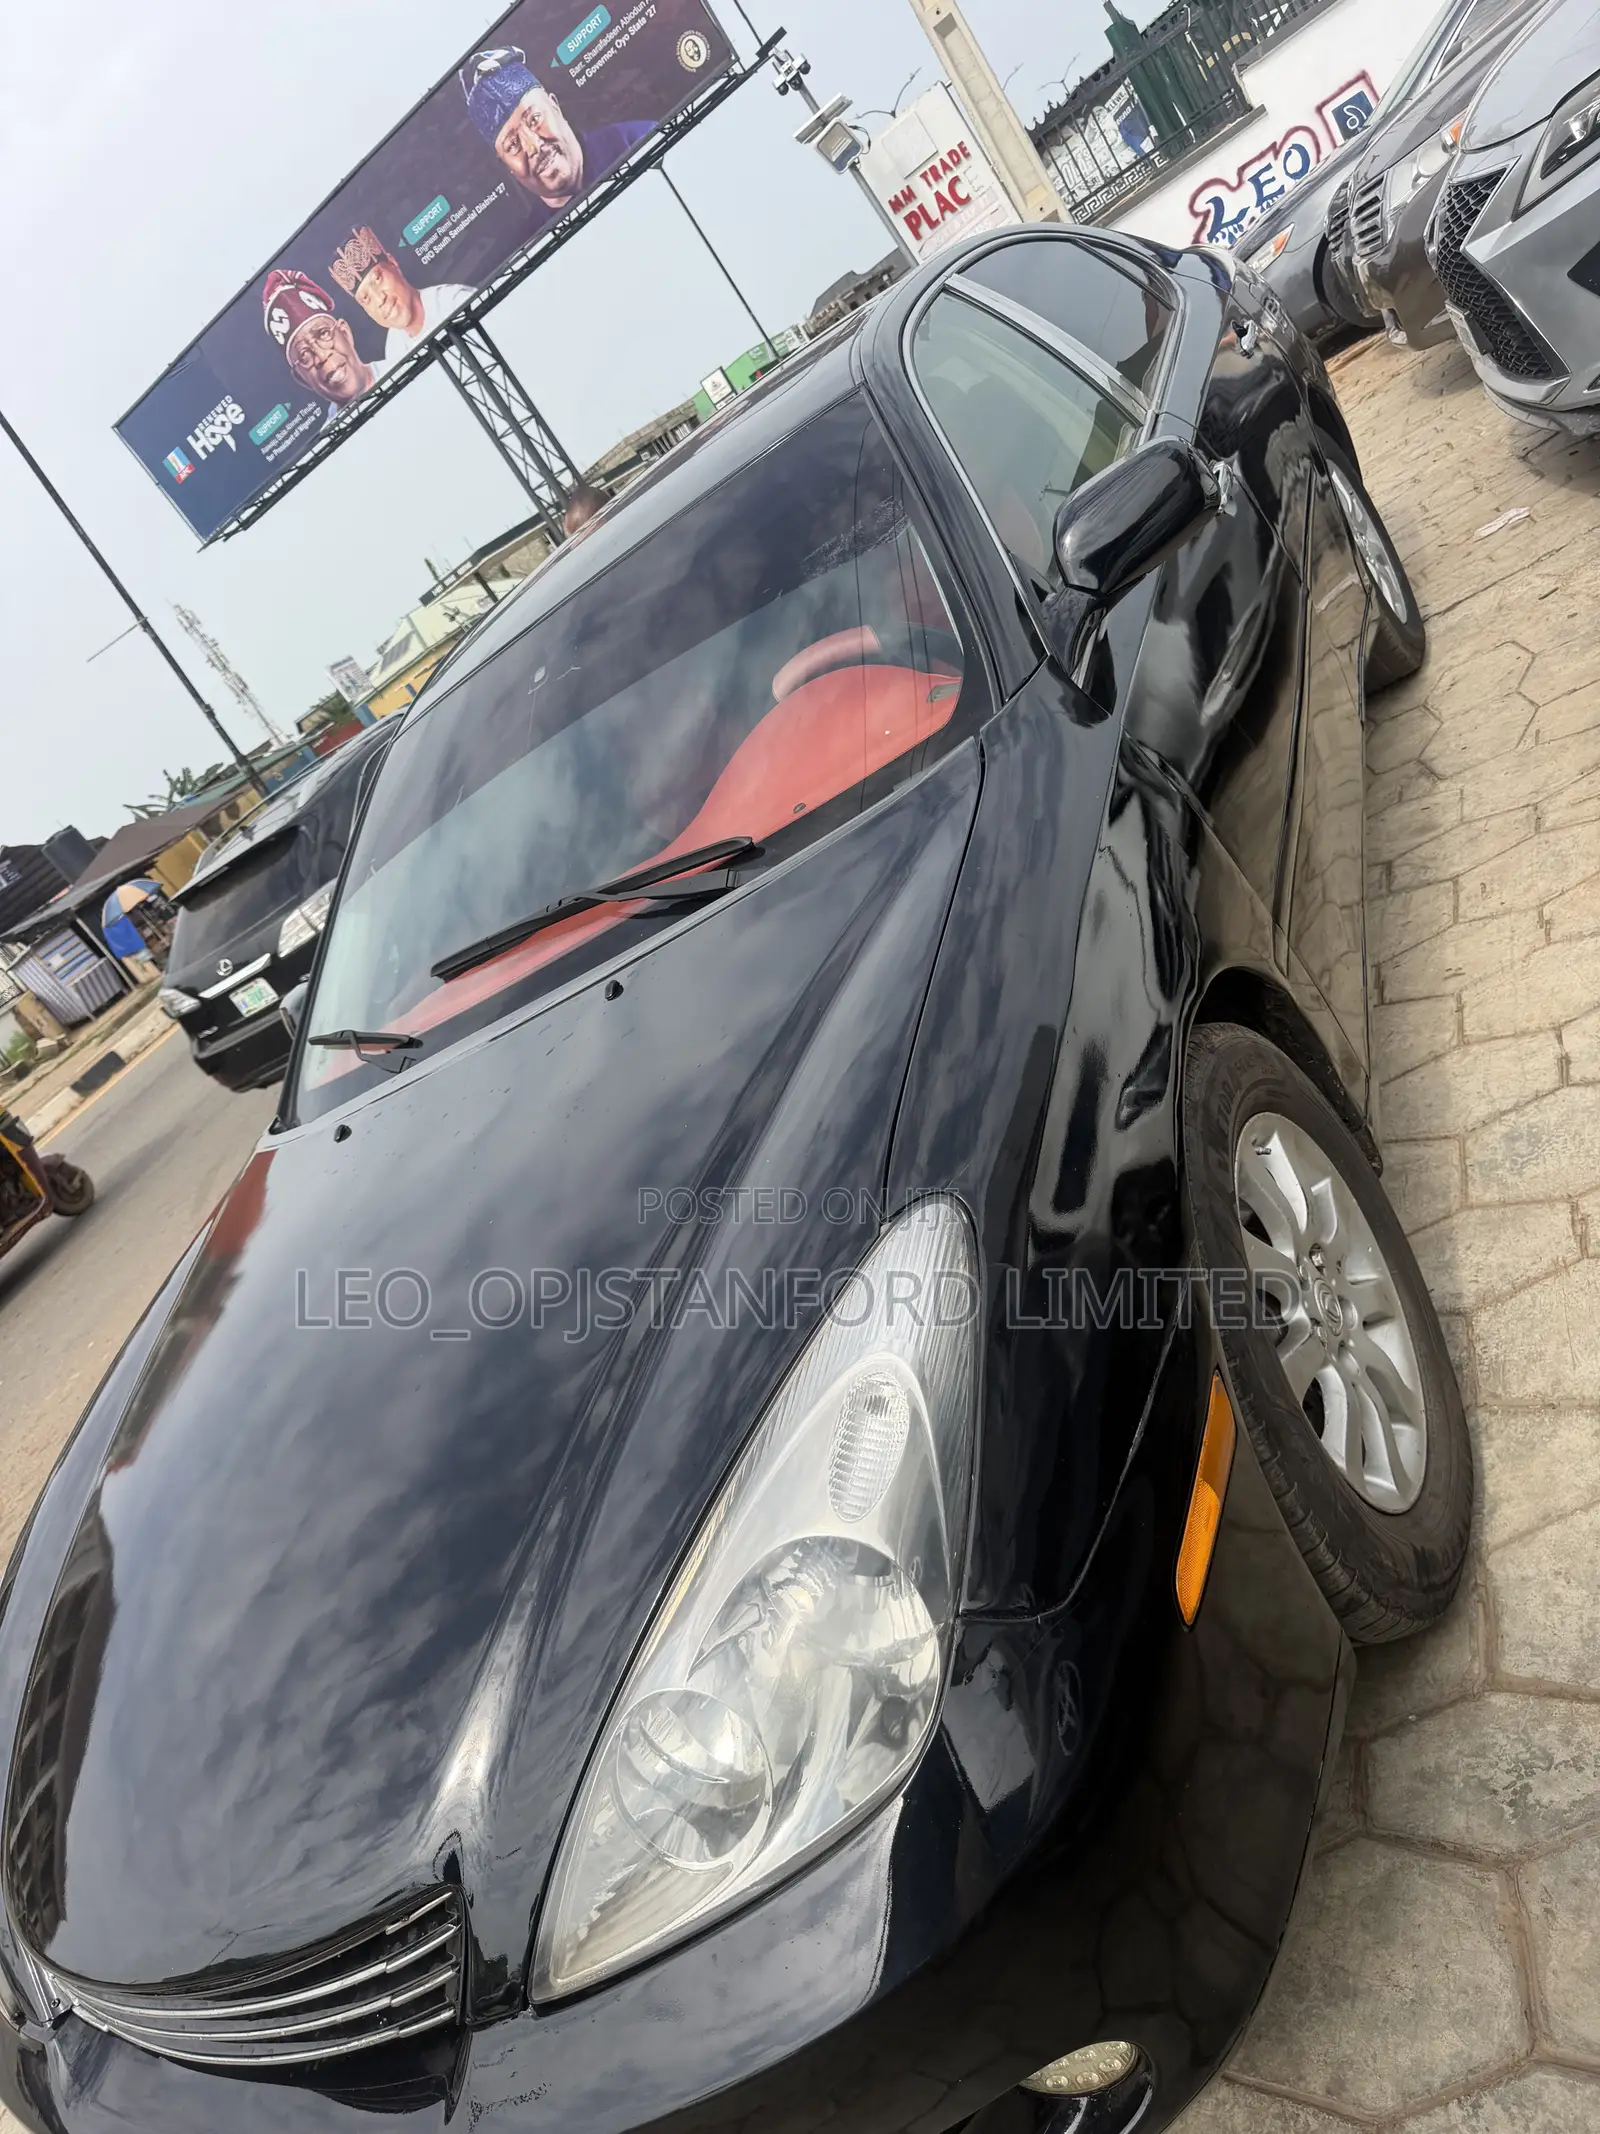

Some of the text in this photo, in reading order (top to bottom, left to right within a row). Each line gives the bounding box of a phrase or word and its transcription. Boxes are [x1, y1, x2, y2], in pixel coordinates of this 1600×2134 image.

[567, 13, 602, 52] SUPPORT
[575, 4, 657, 88] for Governor, Oyo State '27
[583, 24, 622, 63] Sharafadeen
[619, 0, 647, 29] Abiodun
[888, 184, 918, 215] MM
[919, 140, 972, 190] TRADE
[1205, 143, 1311, 244] LEO
[411, 202, 443, 235] SUPPORT
[414, 231, 440, 256] Engineer
[449, 204, 468, 223] Oseni
[433, 235, 452, 254] South
[448, 209, 478, 239] Senatorial
[475, 190, 498, 214] District
[186, 403, 246, 461] Hope
[197, 394, 233, 431] RENEWED
[256, 410, 282, 437] SUPPORT
[272, 434, 296, 456] President
[298, 415, 316, 433] Nigeria
